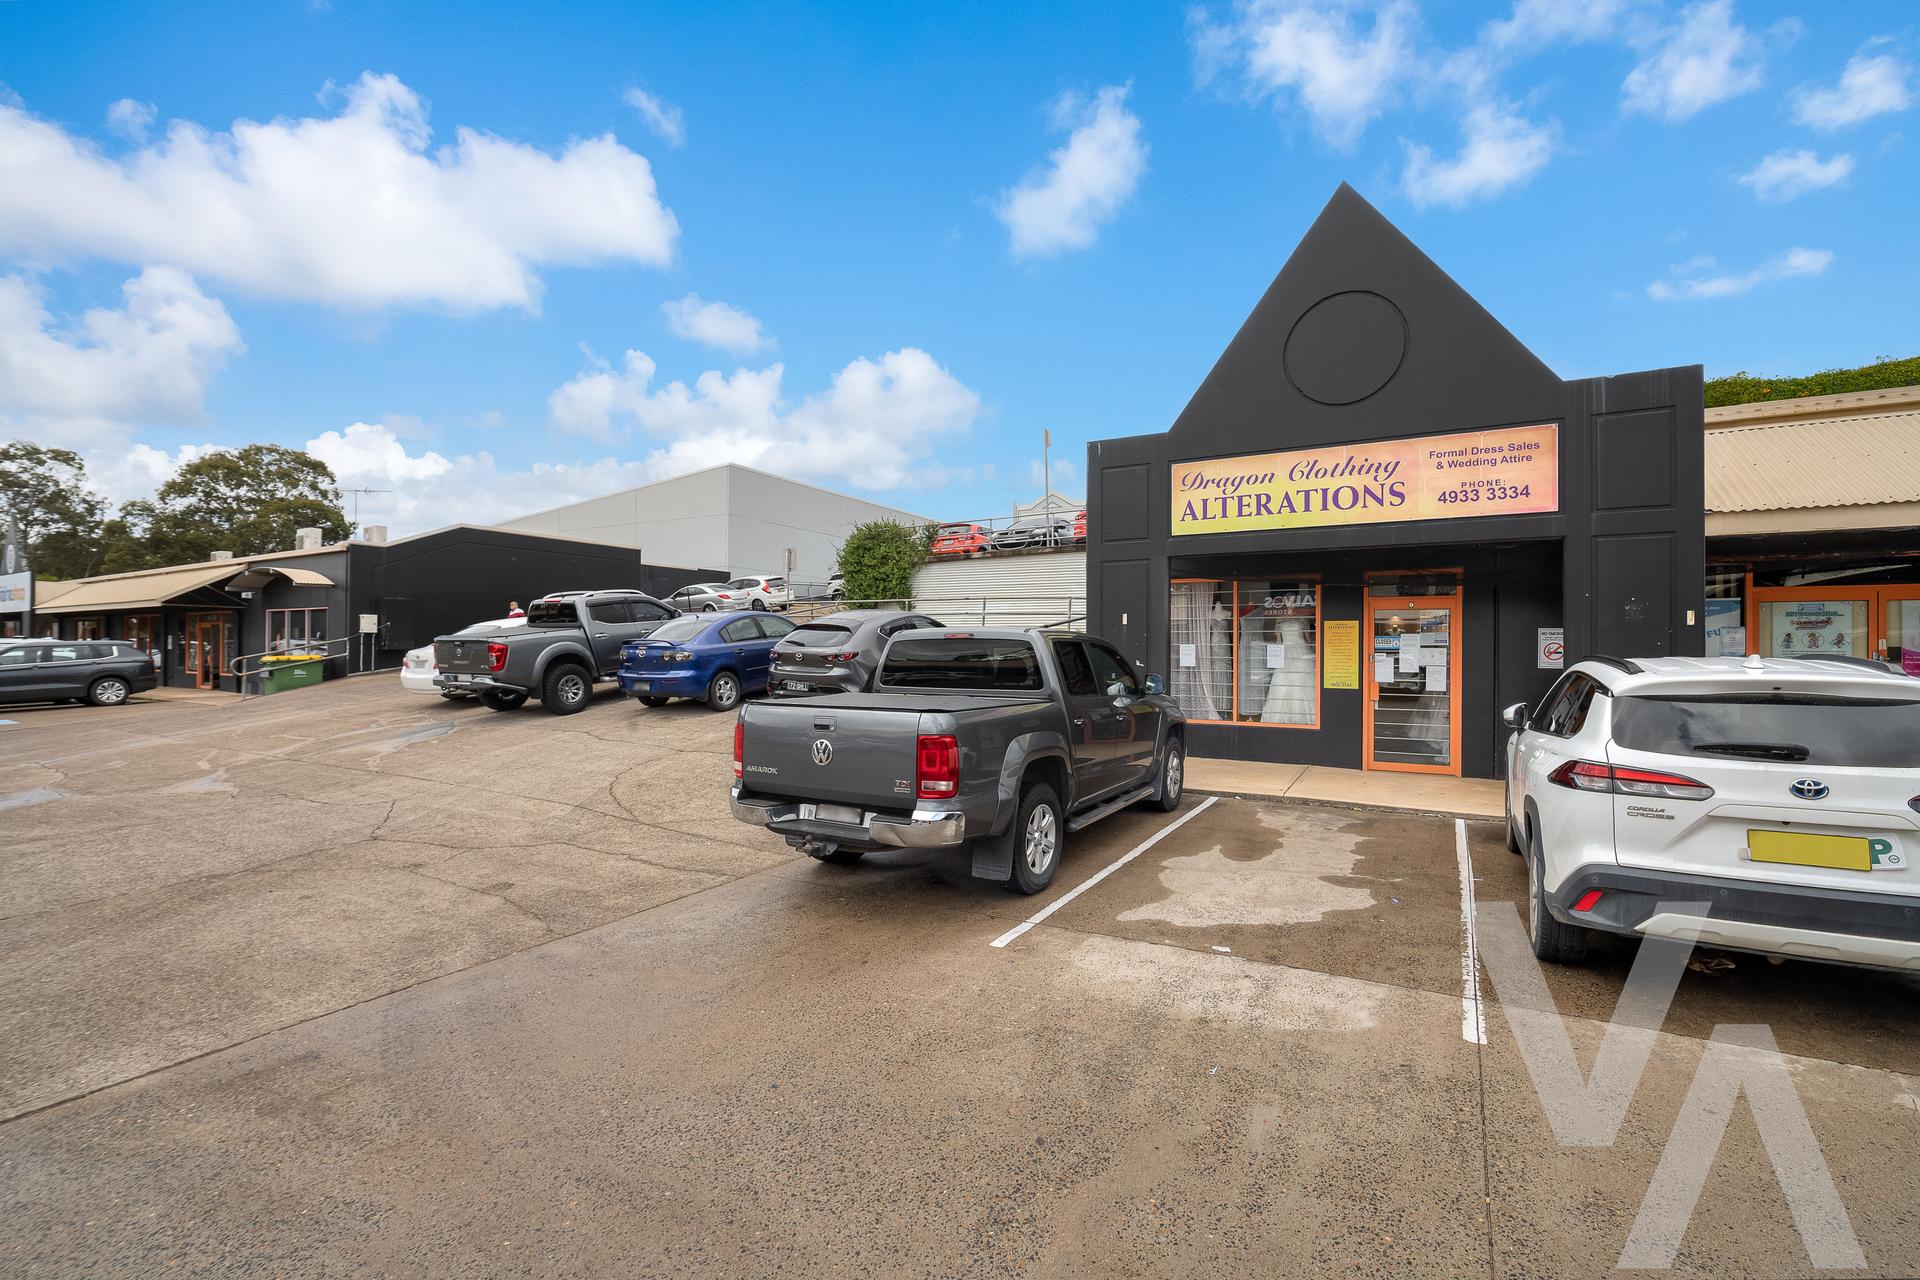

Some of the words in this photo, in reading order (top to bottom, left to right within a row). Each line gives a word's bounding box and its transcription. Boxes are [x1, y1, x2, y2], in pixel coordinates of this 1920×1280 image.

[1429, 447, 1468, 460] Formal
[1471, 445, 1504, 456] Dress
[1508, 441, 1541, 452] Sales
[1436, 461, 1444, 470] &
[1447, 456, 1497, 469] Wedding
[1500, 454, 1533, 465] Attire
[1179, 469, 1280, 496] Dragon
[1288, 455, 1404, 482] Clothing
[1461, 478, 1506, 489] PHONE:
[1179, 481, 1407, 522] ALTERATIONS
[1437, 488, 1480, 504] 4933
[1486, 484, 1531, 501] 3334
[745, 764, 778, 775] AMAROK
[1627, 805, 1666, 813] COROLLA
[1871, 838, 1893, 864] P
